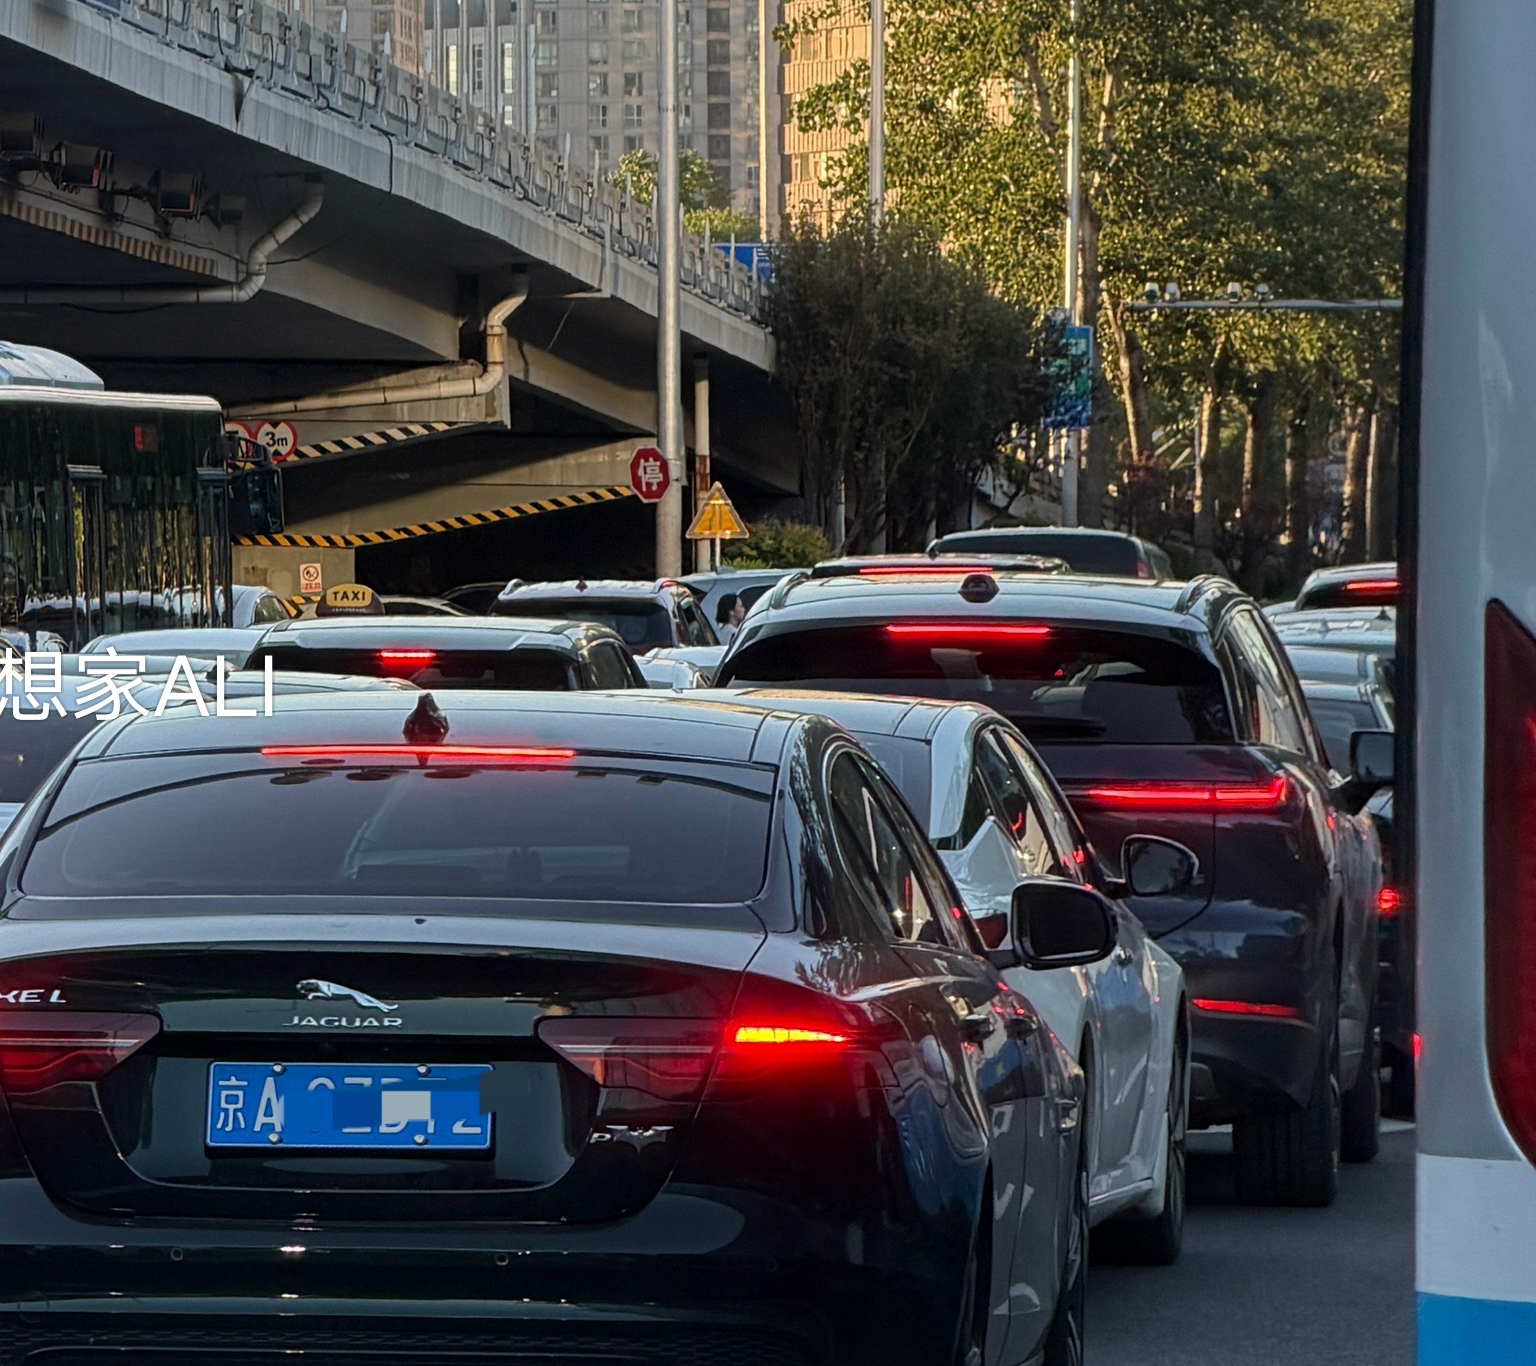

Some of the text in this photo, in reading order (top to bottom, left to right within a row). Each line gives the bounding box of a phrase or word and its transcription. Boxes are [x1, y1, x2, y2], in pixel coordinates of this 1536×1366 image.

[265, 432, 288, 447] 3m
[638, 457, 663, 492] 停
[332, 590, 366, 601] TAXI
[282, 1015, 403, 1028] JAGUAR
